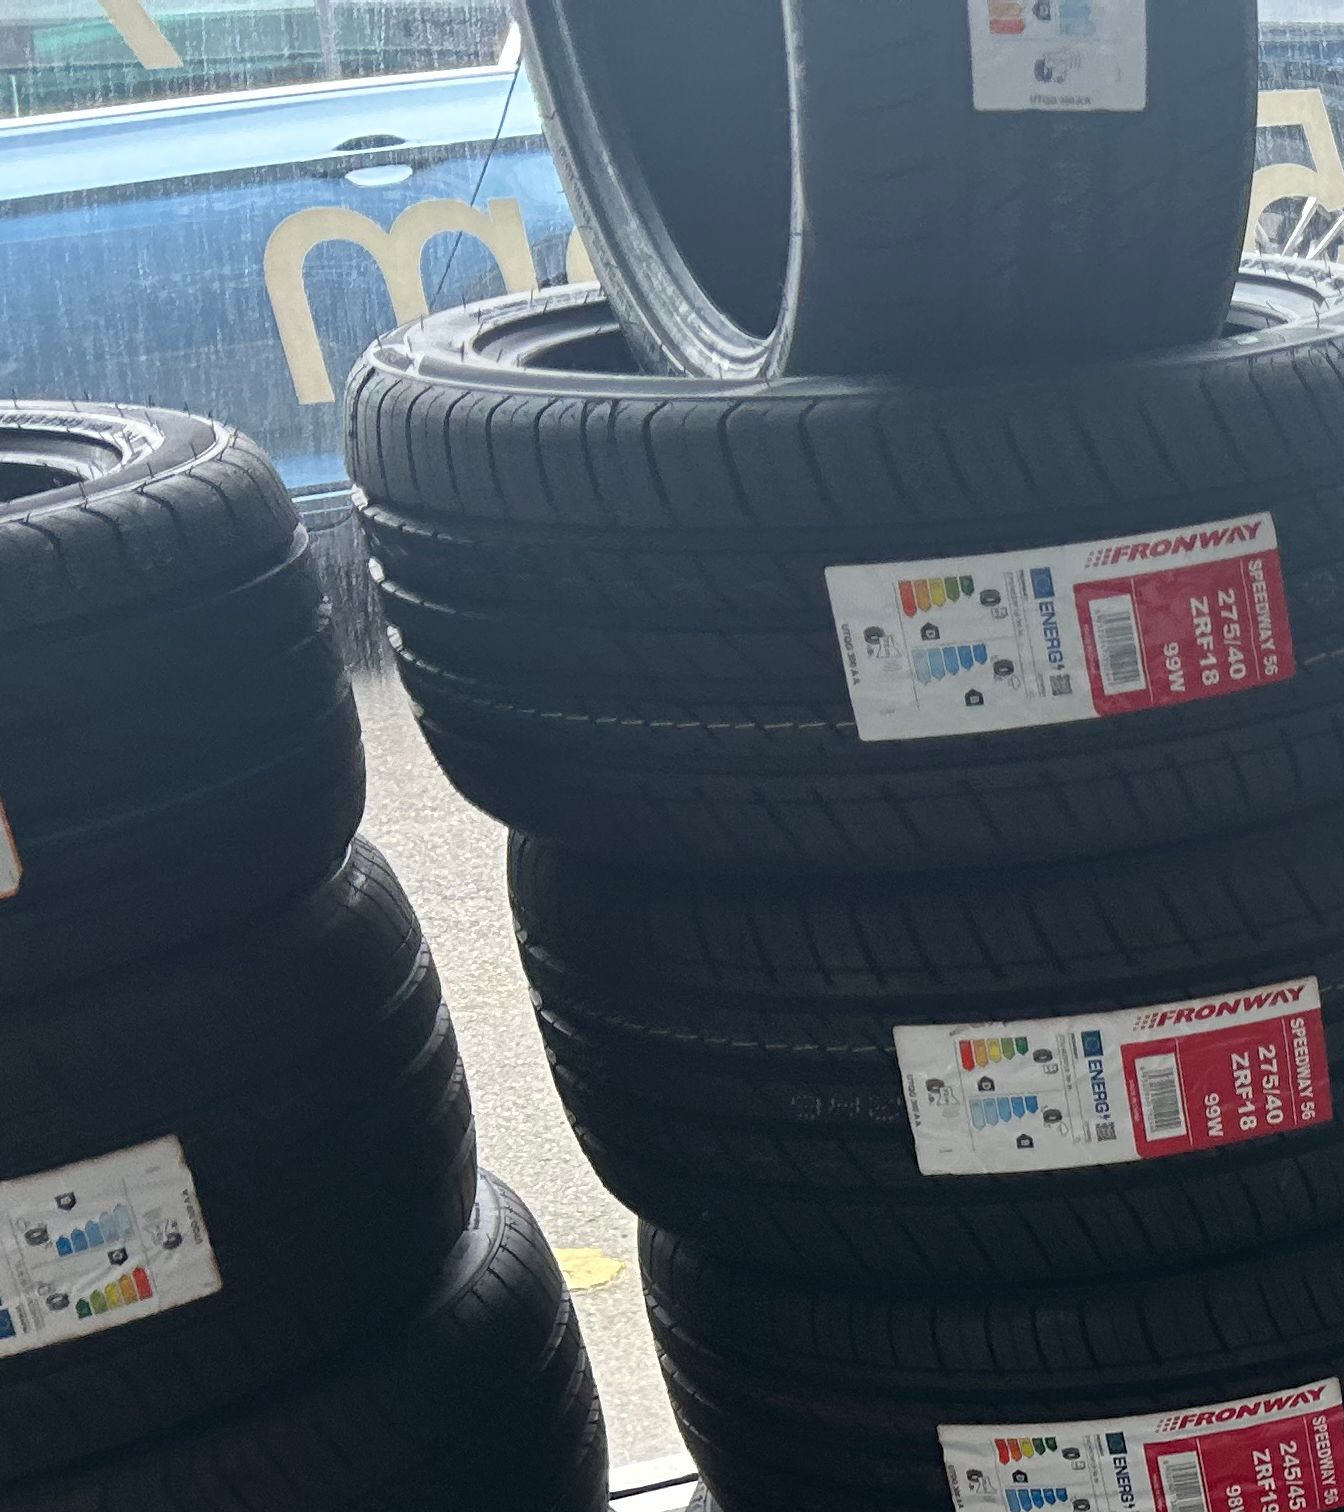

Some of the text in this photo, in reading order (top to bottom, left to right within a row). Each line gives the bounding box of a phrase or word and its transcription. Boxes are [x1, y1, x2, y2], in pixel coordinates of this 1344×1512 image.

[1111, 521, 1262, 564] FRONWAY
[1189, 596, 1220, 687] ZRF18
[1217, 588, 1247, 680] 275/40
[1248, 558, 1279, 677] SPEEDWAY 56
[1163, 641, 1186, 692] 99W
[1156, 985, 1305, 1026] FRONWAY
[1230, 1052, 1258, 1131] ZRF18
[1258, 1044, 1284, 1125] 275/40
[1290, 1017, 1316, 1120] SPEEDWAY 56
[1204, 1092, 1224, 1137] 99W
[1178, 1385, 1327, 1430] FRONWAY
[1279, 1440, 1307, 1511] 245/45
[1312, 1414, 1339, 1505] SPEEDWAY 56
